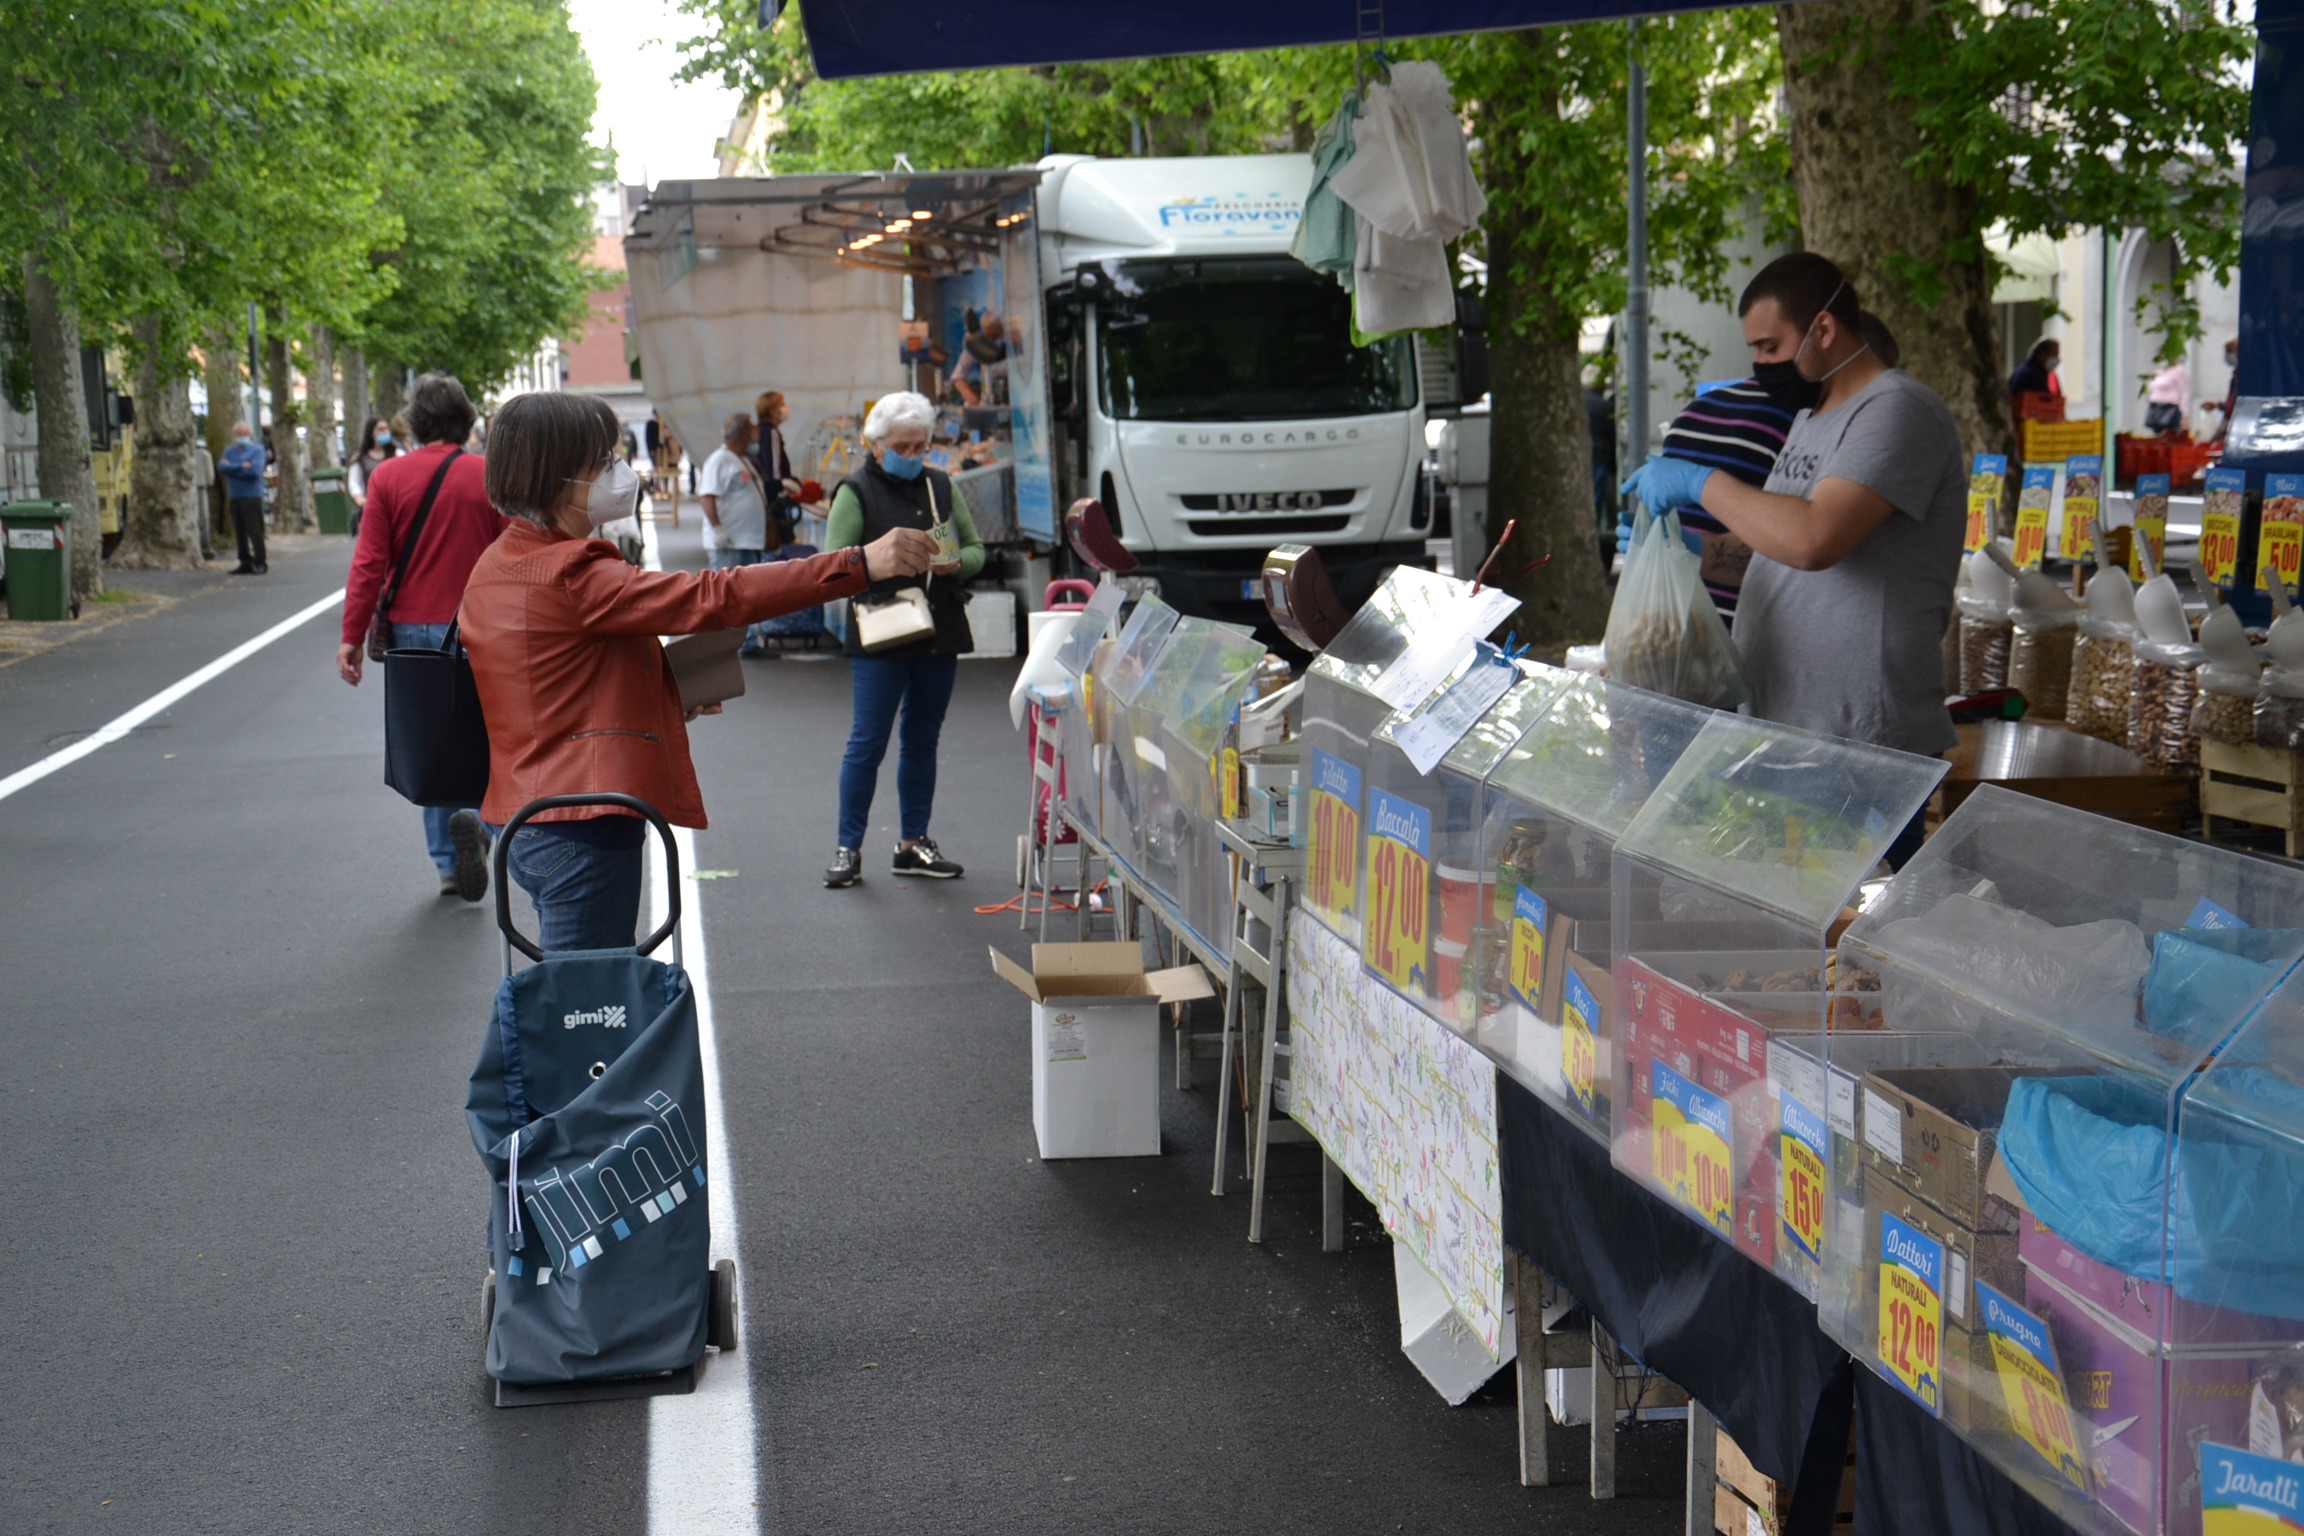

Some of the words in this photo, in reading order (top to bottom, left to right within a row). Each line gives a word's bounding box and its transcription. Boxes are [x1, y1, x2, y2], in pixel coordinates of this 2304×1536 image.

[1159, 203, 1301, 228] Fioravan
[1176, 429, 1360, 446] EUROCARGO
[1217, 491, 1322, 514] IVECO
[934, 525, 948, 540] 20
[2206, 518, 2233, 532] SECCHE
[1376, 799, 1420, 849] Baccalà
[563, 1008, 604, 1030] gimi
[1573, 985, 1589, 1019] Noci
[1783, 1104, 1826, 1156] Albicocche
[1790, 1142, 1821, 1180] NATURALI
[1887, 1228, 1933, 1278] Datteri
[1891, 1270, 1927, 1308] NATURALI
[1988, 1299, 2042, 1350] Prugne
[1995, 1339, 2059, 1397] DENOCCIOLATE
